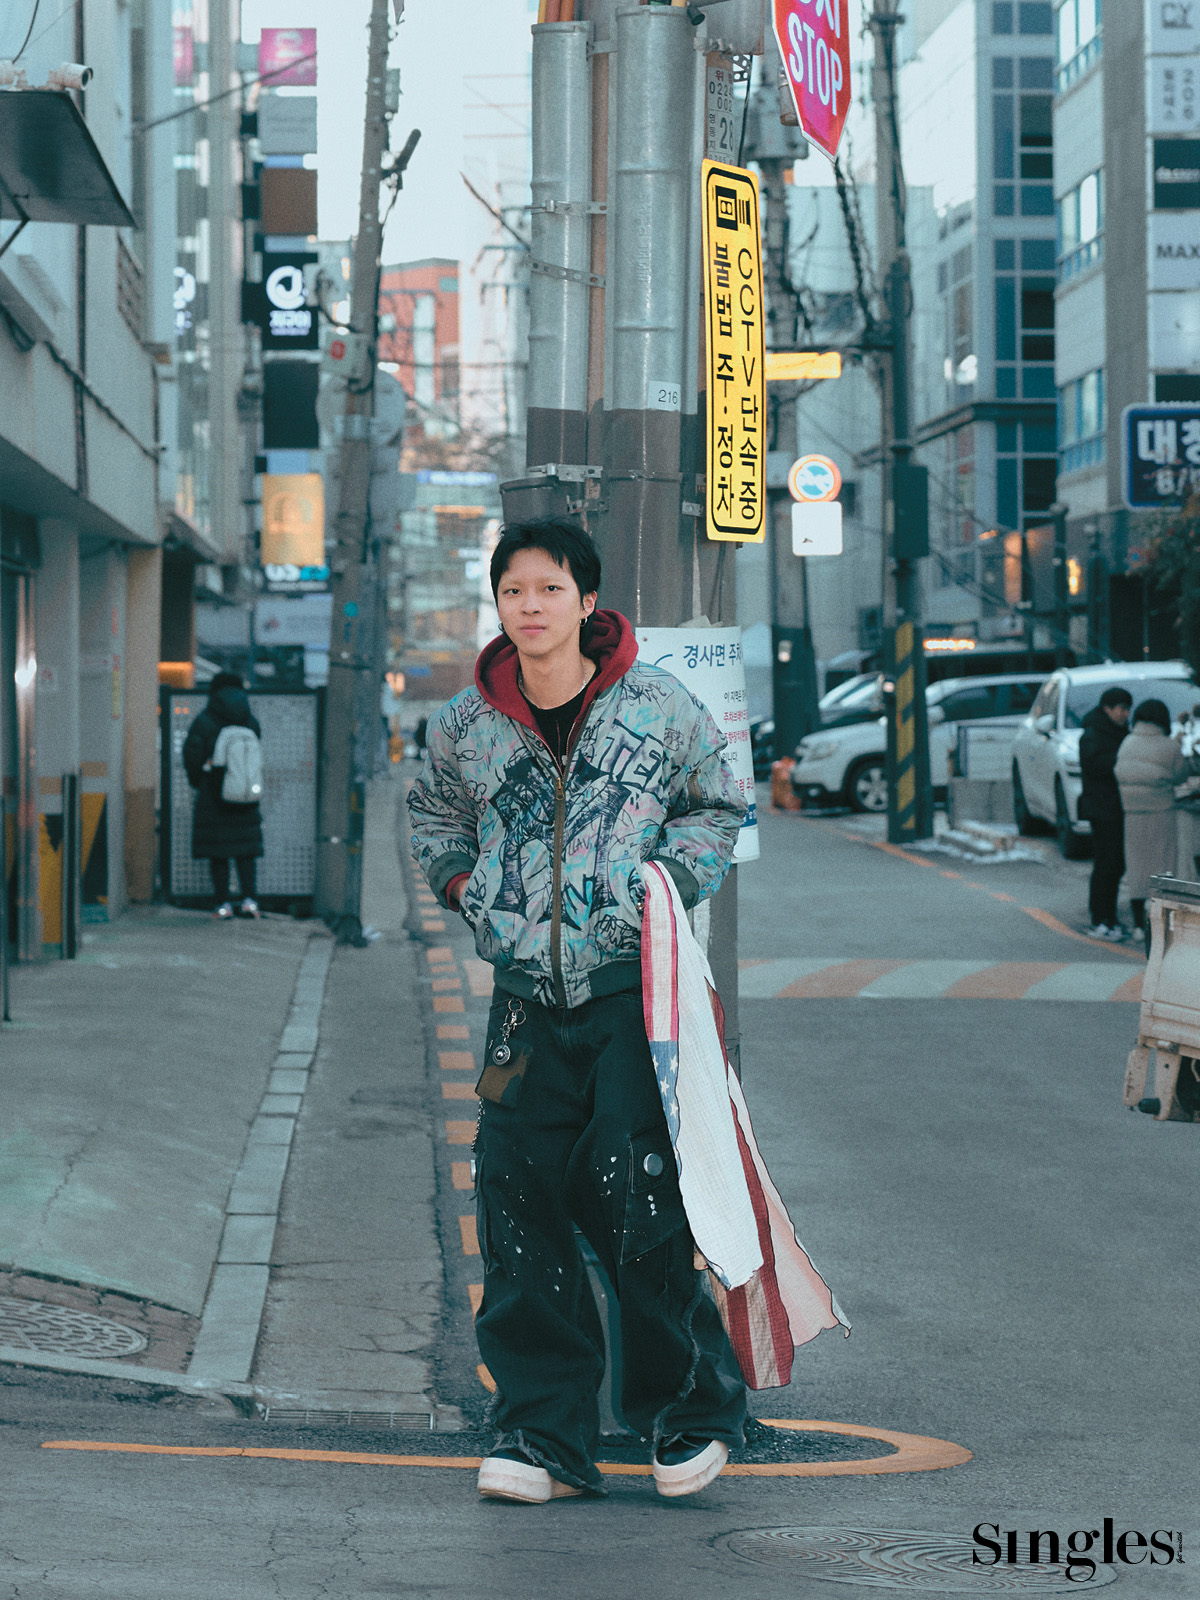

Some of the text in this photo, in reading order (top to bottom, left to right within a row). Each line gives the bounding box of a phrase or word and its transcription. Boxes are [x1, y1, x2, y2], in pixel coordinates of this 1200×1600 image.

[787, 12, 843, 117] STOP
[713, 242, 732, 338] 불법
[658, 389, 678, 405] 216
[683, 644, 725, 669] 경사면
